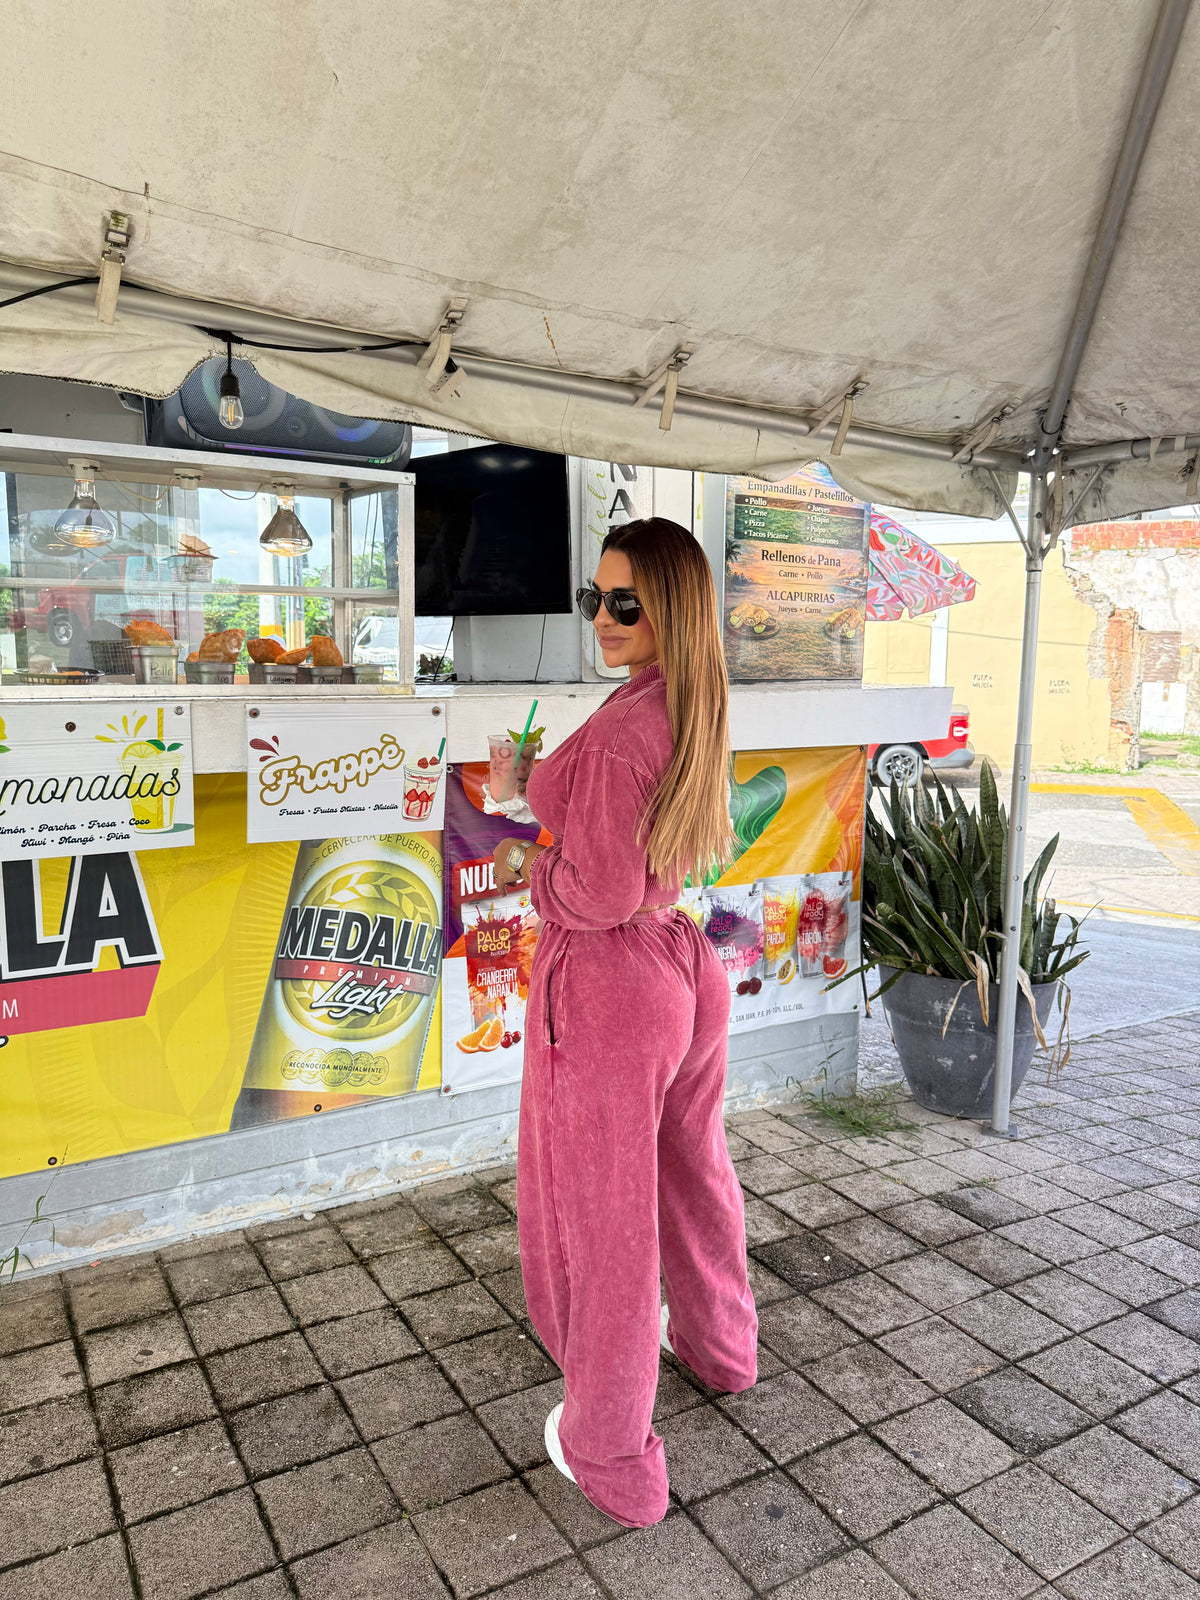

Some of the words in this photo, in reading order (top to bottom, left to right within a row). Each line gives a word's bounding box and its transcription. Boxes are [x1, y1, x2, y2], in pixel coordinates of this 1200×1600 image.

[747, 481, 807, 496] Empanadillas
[814, 487, 854, 504] Pastelillos
[749, 497, 767, 506] Pollo
[748, 508, 768, 518] Carne
[811, 504, 830, 514] Jueyes
[748, 519, 765, 528] Pizza
[748, 530, 766, 538] Tacos
[767, 532, 789, 541] Picante
[761, 549, 806, 565] Rellenos
[808, 555, 816, 565] de
[817, 554, 841, 567] Pana
[778, 570, 799, 578] Carne
[806, 571, 823, 580] Pollo
[766, 590, 836, 604] ALCAPURRIAS
[777, 605, 798, 615] Jueyes
[805, 606, 823, 614] Carne
[279, 808, 305, 816] Fresas
[313, 806, 338, 815] Frutas
[340, 805, 366, 813] Mixtas
[373, 803, 399, 811] Nutella
[38, 823, 77, 833] Parcha
[88, 820, 117, 829] Fresa
[129, 817, 151, 826] Coco
[21, 838, 47, 848] Kiwi
[58, 835, 95, 846] Mangó
[106, 832, 131, 842] Piña
[396, 834, 429, 860] PUERTO
[428, 856, 443, 879] RICO
[279, 906, 443, 977] MEDALLA
[477, 928, 510, 945] PALO
[477, 940, 511, 954] ready
[303, 964, 411, 986] PREMIUM
[477, 968, 518, 987] CRANBERRY
[310, 970, 406, 1020] Light
[289, 1061, 331, 1070] RECONOCIDA
[332, 1065, 383, 1074] MUNDIALMENTE
